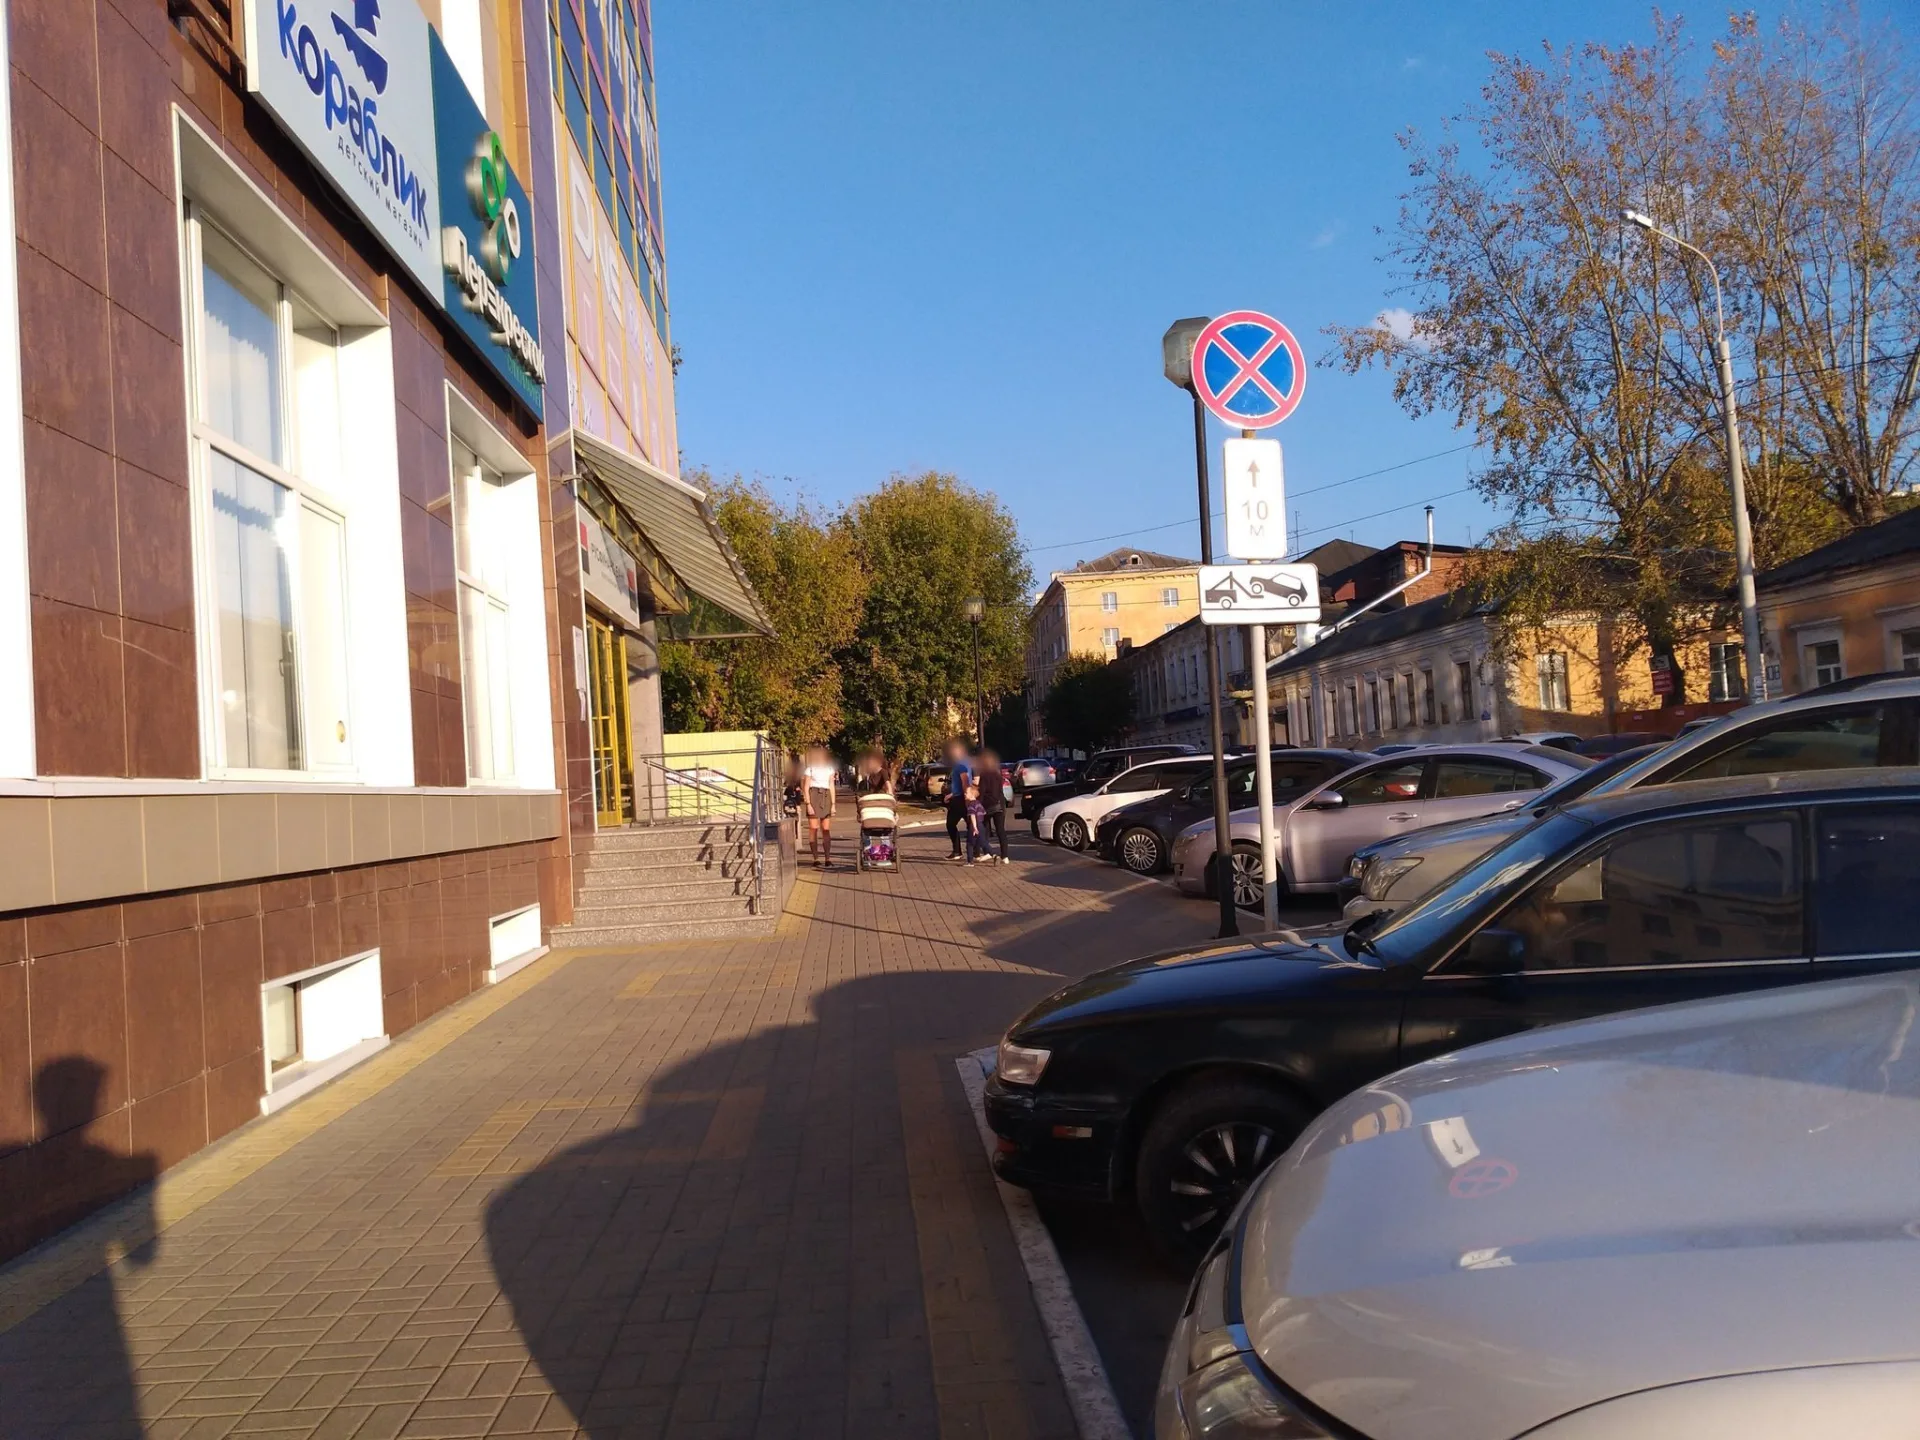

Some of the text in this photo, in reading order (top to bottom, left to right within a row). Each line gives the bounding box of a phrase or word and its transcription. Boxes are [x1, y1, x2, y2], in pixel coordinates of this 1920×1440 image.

[337, 134, 424, 252] детский магазин
[1242, 500, 1268, 520] 10
